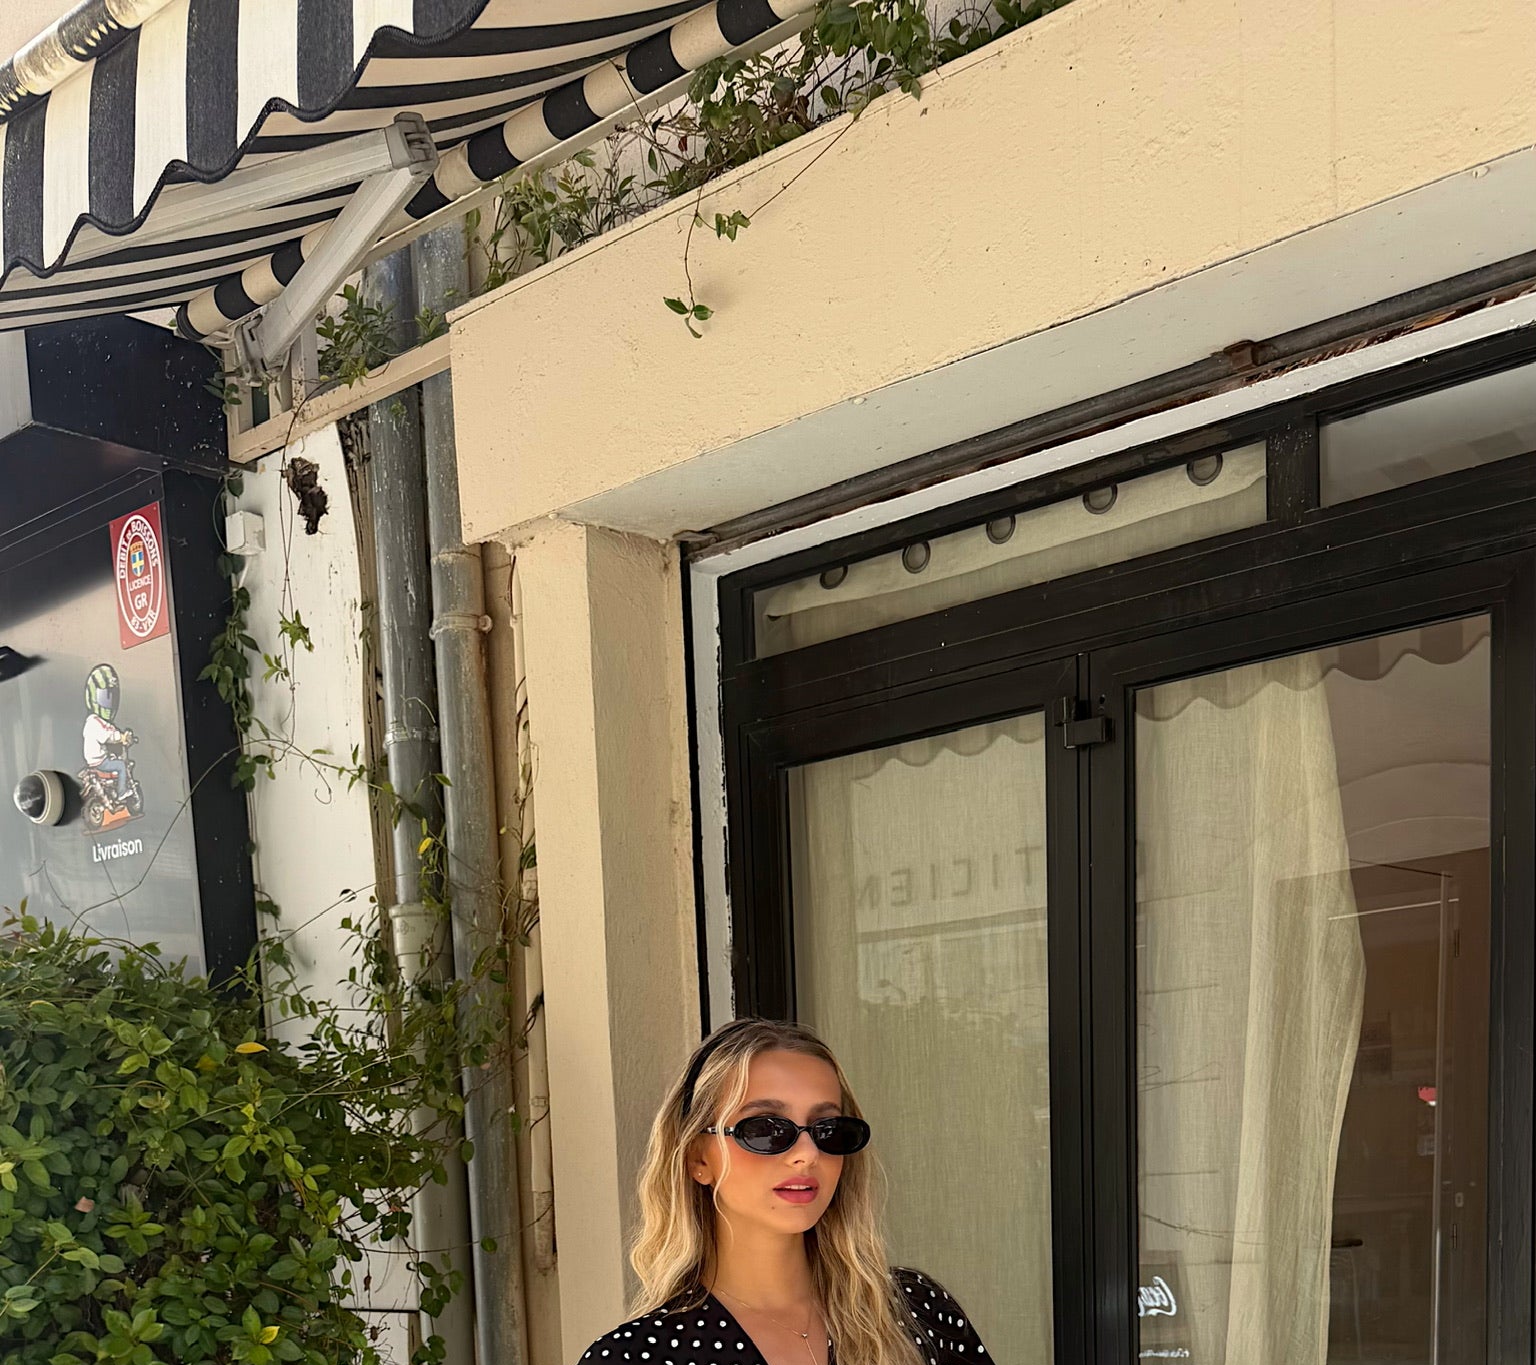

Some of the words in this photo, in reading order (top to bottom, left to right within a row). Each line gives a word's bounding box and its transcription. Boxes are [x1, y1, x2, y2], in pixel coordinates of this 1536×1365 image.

[131, 520, 159, 567] BOISSONS
[129, 574, 152, 592] LICENCE
[134, 592, 148, 610] GR
[92, 838, 143, 863] Livraison
